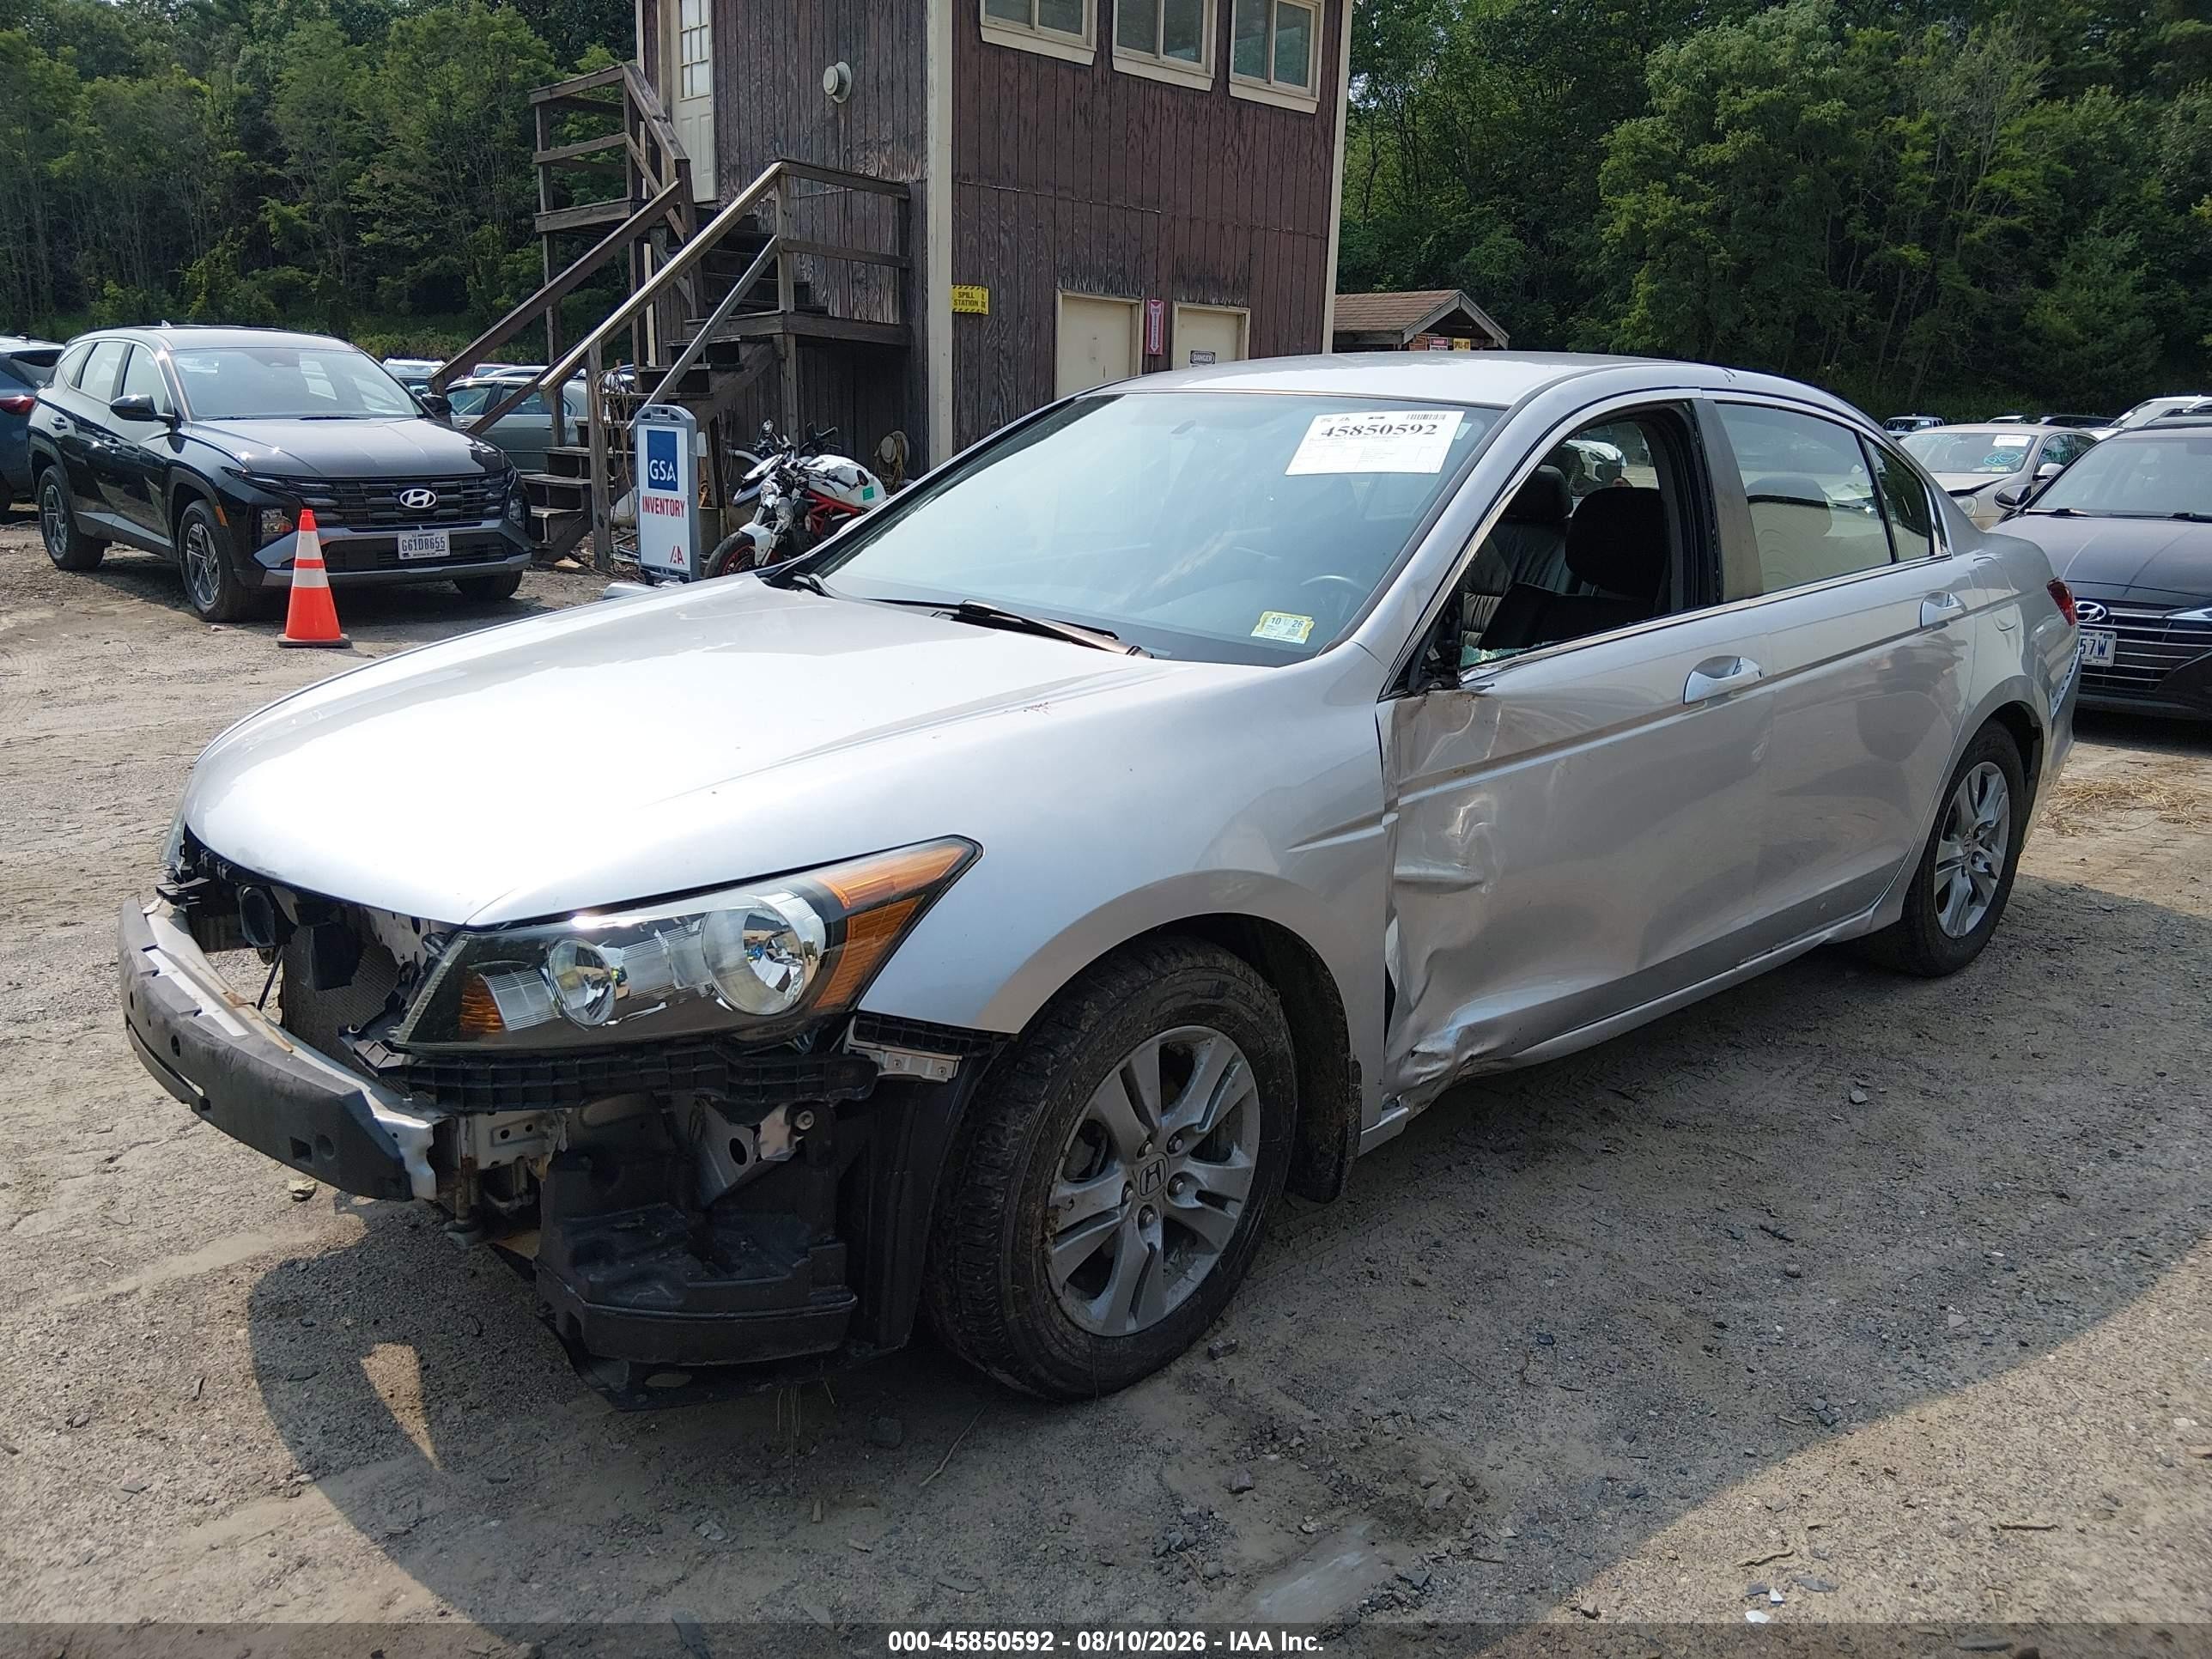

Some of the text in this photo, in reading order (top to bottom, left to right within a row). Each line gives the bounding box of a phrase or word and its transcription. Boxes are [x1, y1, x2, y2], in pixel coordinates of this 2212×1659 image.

[1194, 353, 1213, 362] DANGER
[1321, 423, 1437, 437] 45850592
[649, 459, 677, 483] GSA
[642, 495, 685, 519] INVENTORY
[1291, 619, 1304, 628] 26
